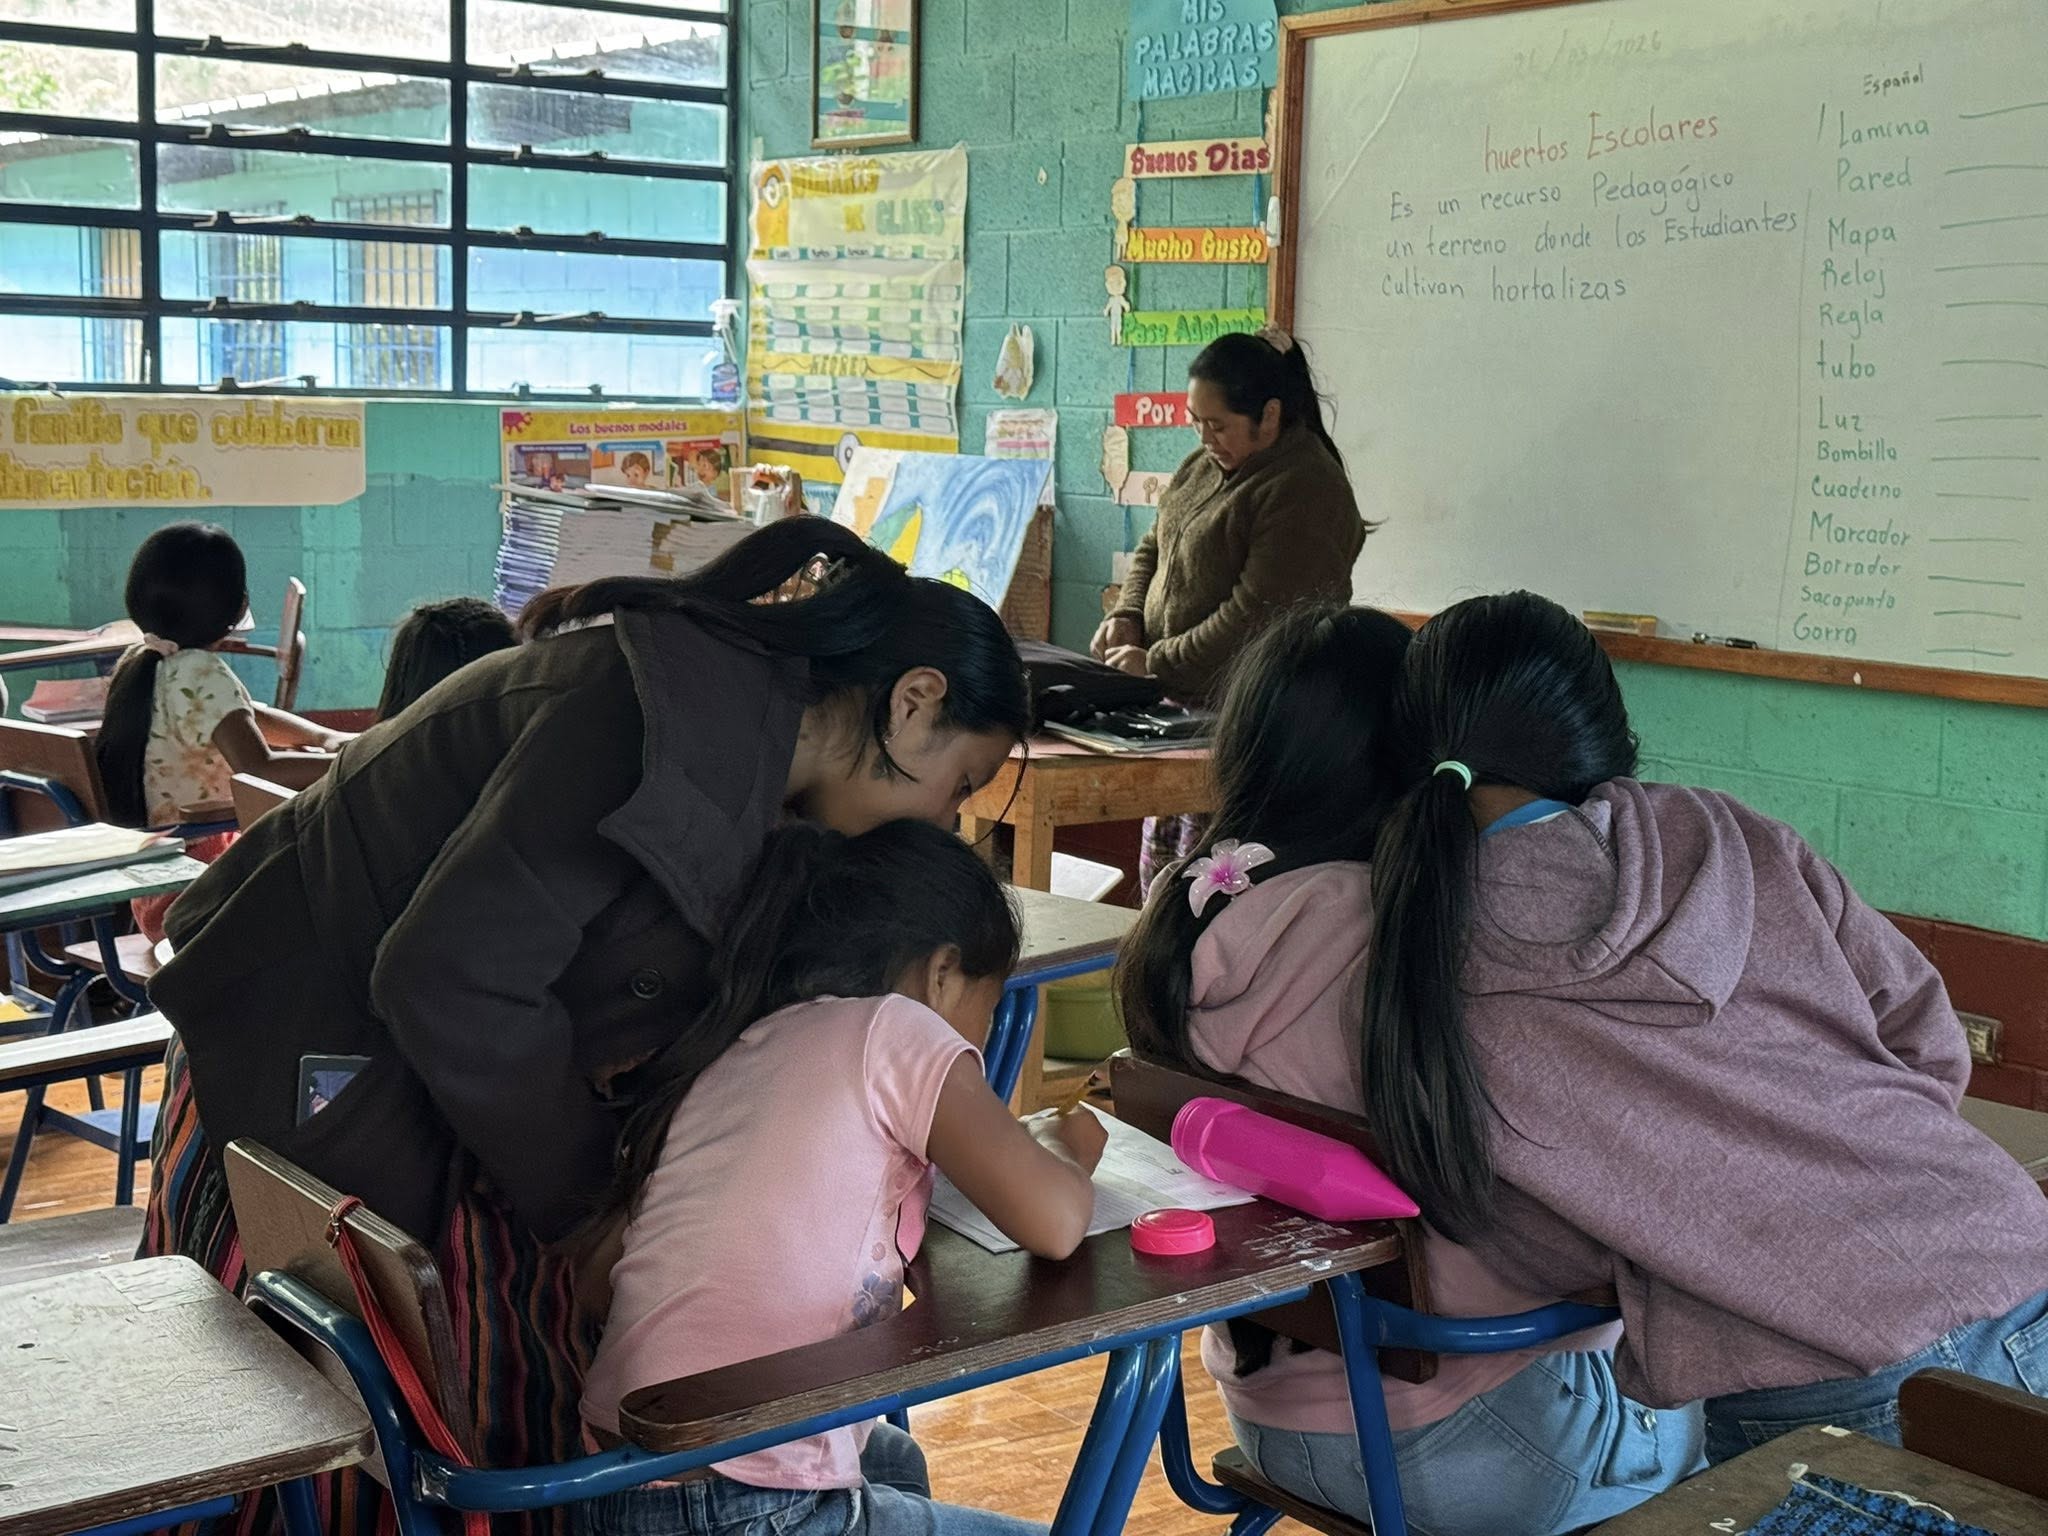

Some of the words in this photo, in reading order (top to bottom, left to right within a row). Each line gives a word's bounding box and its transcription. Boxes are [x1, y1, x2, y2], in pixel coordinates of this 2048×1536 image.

[1134, 19, 1276, 65] PALABRAS
[1142, 56, 1261, 98] MAGICAS
[1863, 63, 1924, 97] Español
[1484, 124, 1569, 173] huertos
[1587, 105, 1719, 160] Escolares
[1130, 147, 1198, 176] Buenos
[1205, 142, 1271, 172] Dias
[1836, 157, 1913, 194] Pared
[1390, 191, 1414, 222] Es
[1437, 198, 1462, 216] un
[1479, 185, 1562, 211] recurso
[1592, 164, 1735, 217] Pedagógico
[1127, 229, 1195, 260] Mucho
[1200, 229, 1263, 260] Gusto
[1385, 239, 1415, 259] un
[1426, 224, 1507, 258] terreno
[1534, 220, 1593, 254] donde
[1616, 213, 1648, 249] los
[1663, 200, 1799, 245] Estudiantes
[1827, 217, 1898, 254] Mapa
[1381, 265, 1466, 299] Cultivan
[1491, 264, 1627, 303] hortalizas
[1820, 257, 1886, 300] Reloj
[1123, 311, 1168, 344] Pase
[1819, 299, 1885, 340] Regla
[1816, 338, 1877, 379] tubo
[13, 397, 124, 445] familia
[136, 411, 199, 460] que
[568, 421, 591, 434] Los
[593, 421, 636, 434] buenos
[637, 418, 688, 433] modales
[1135, 396, 1176, 425] Por
[1818, 395, 1864, 432] Luz
[1816, 437, 1898, 462] Bombilla
[1808, 510, 1911, 546] Marcador
[1803, 551, 1902, 576] Borrador
[1800, 585, 1896, 616] Sacapunta
[1793, 612, 1858, 645] Gorra
